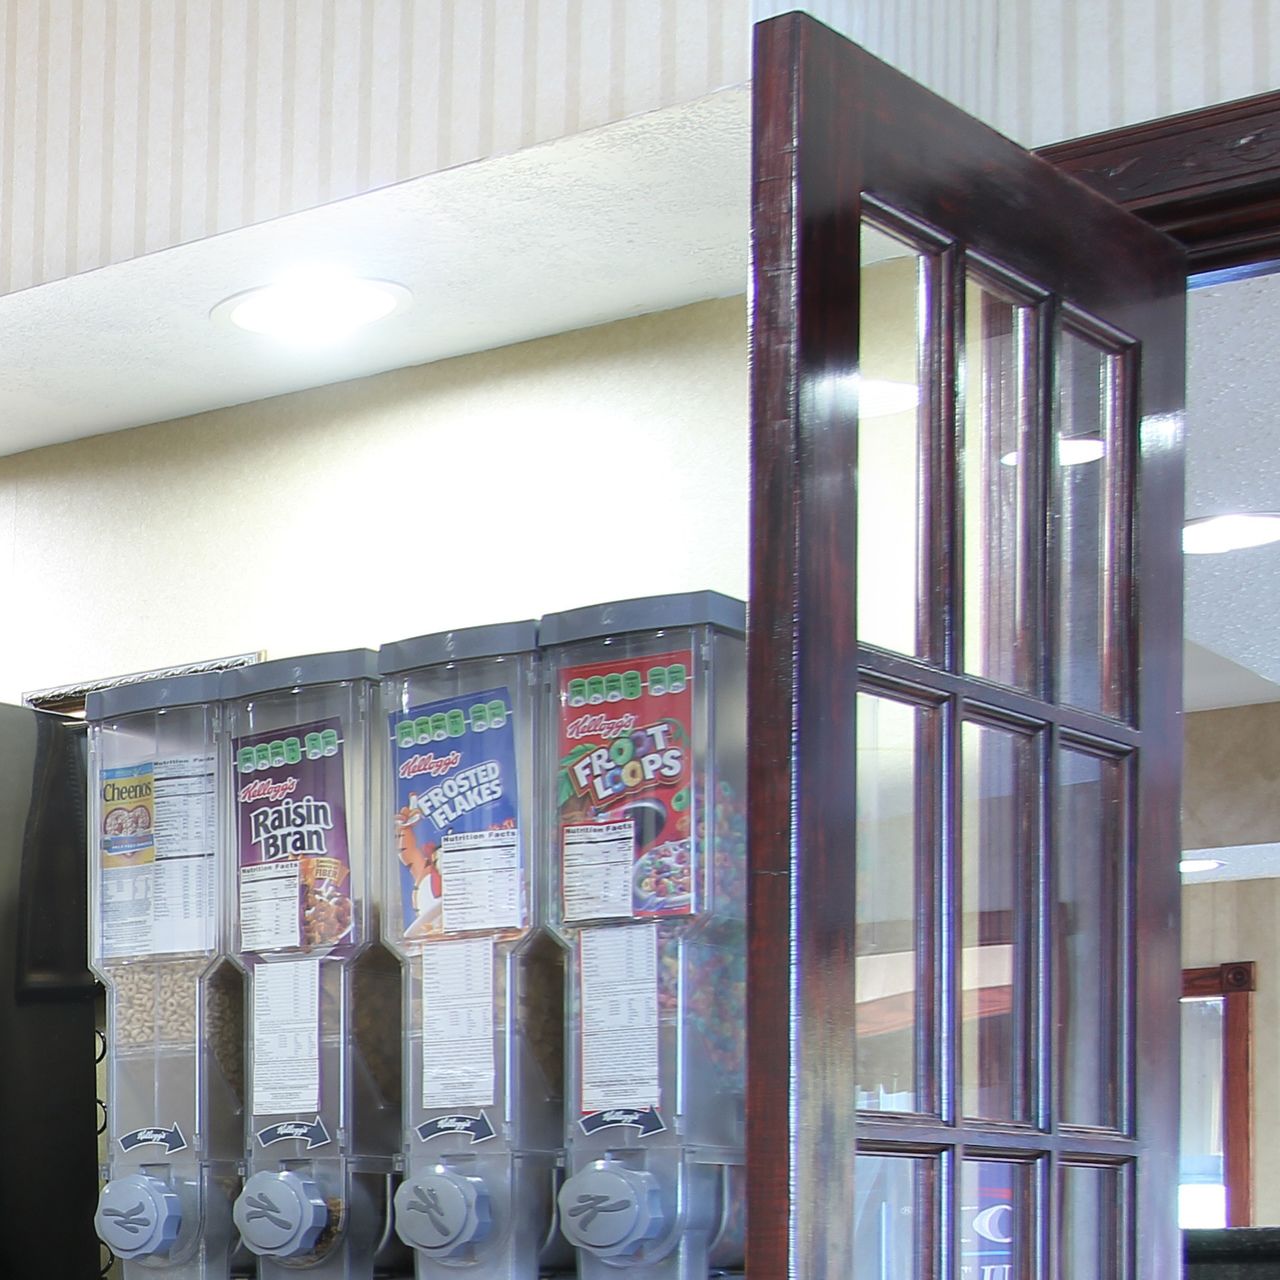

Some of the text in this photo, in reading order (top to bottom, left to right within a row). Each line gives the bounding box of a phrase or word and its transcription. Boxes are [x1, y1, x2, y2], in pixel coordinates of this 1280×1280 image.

[567, 713, 635, 739] Kellogg's
[399, 751, 461, 779] Kellogg's
[593, 749, 682, 800] LOOPS
[240, 777, 298, 802] Kellogg's
[418, 761, 500, 817] FROSTED
[429, 779, 503, 830] FLAKES
[251, 796, 332, 844] Raisin
[263, 827, 327, 860] Bran
